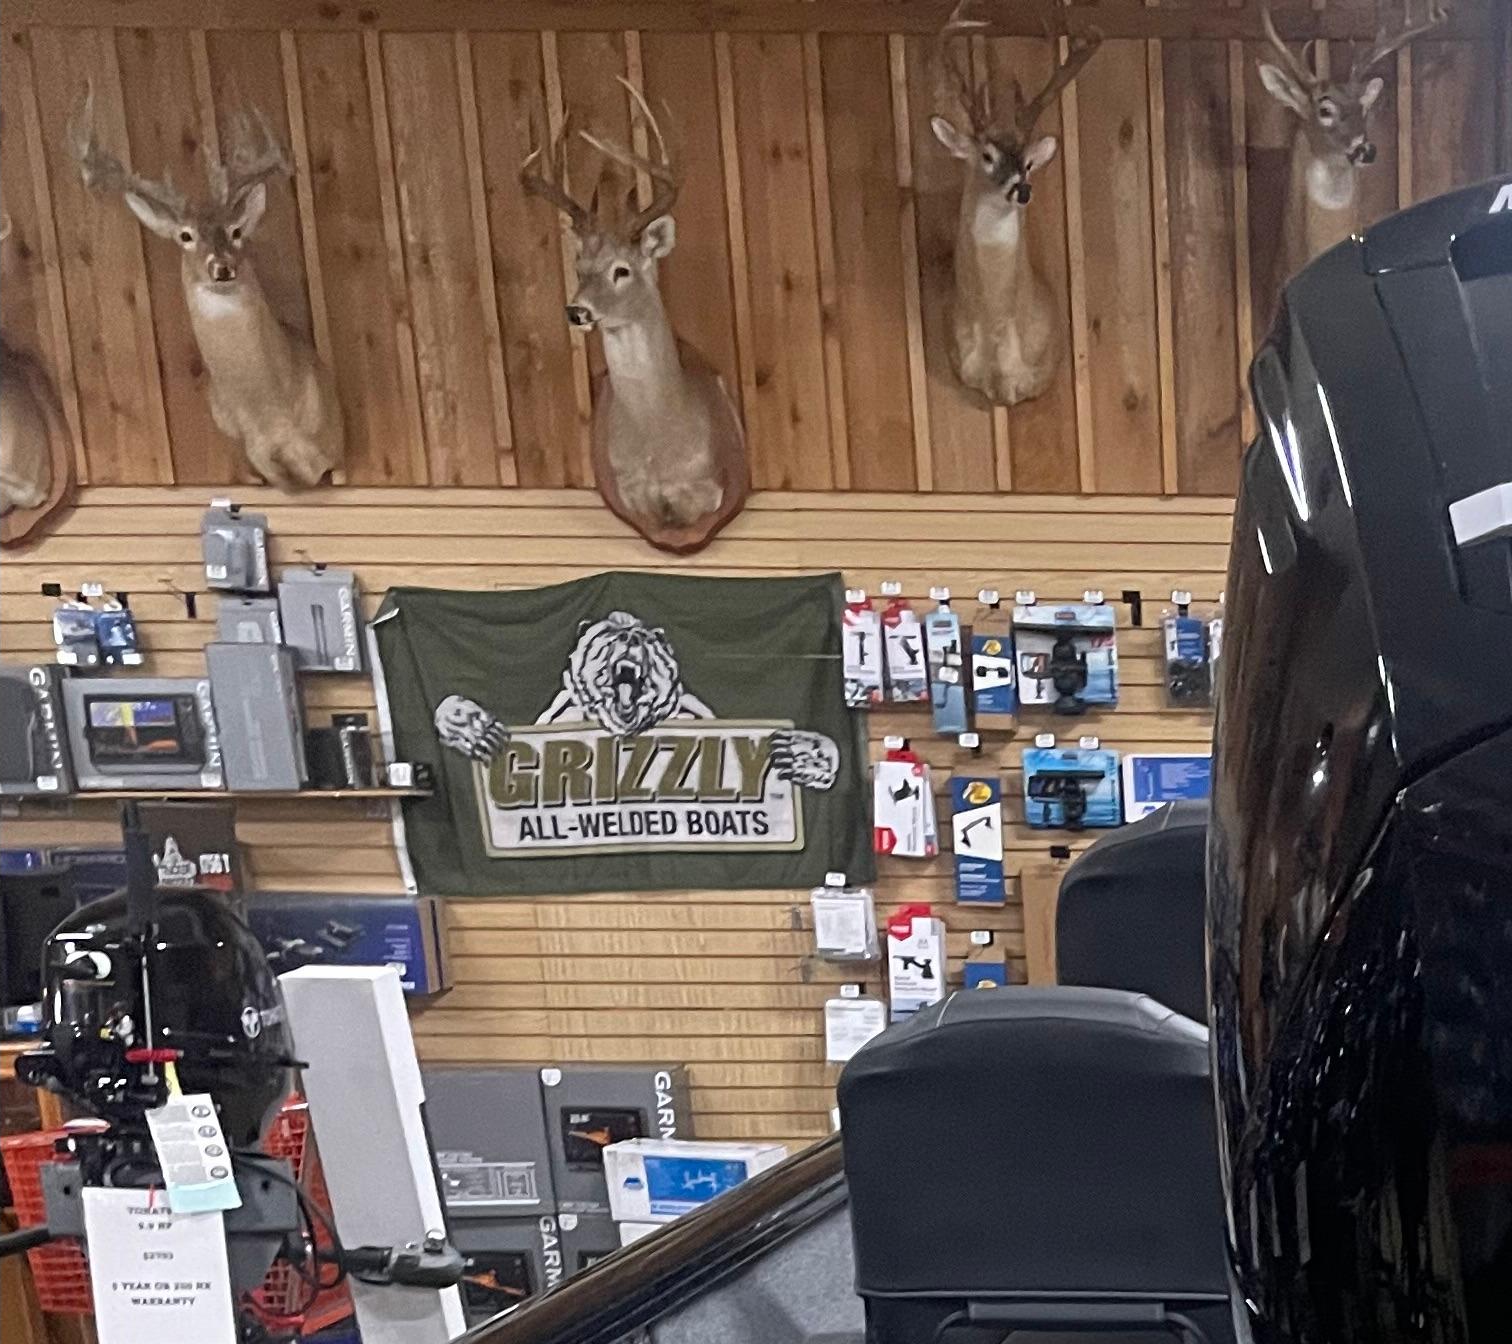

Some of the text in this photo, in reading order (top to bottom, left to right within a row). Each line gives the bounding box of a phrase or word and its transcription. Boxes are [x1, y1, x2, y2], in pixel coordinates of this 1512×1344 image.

[29, 667, 63, 769] GARMIN
[197, 680, 222, 767] GARMIN
[488, 735, 773, 811] GRIZZLY
[519, 810, 770, 842] ALL-WELDED BOATS
